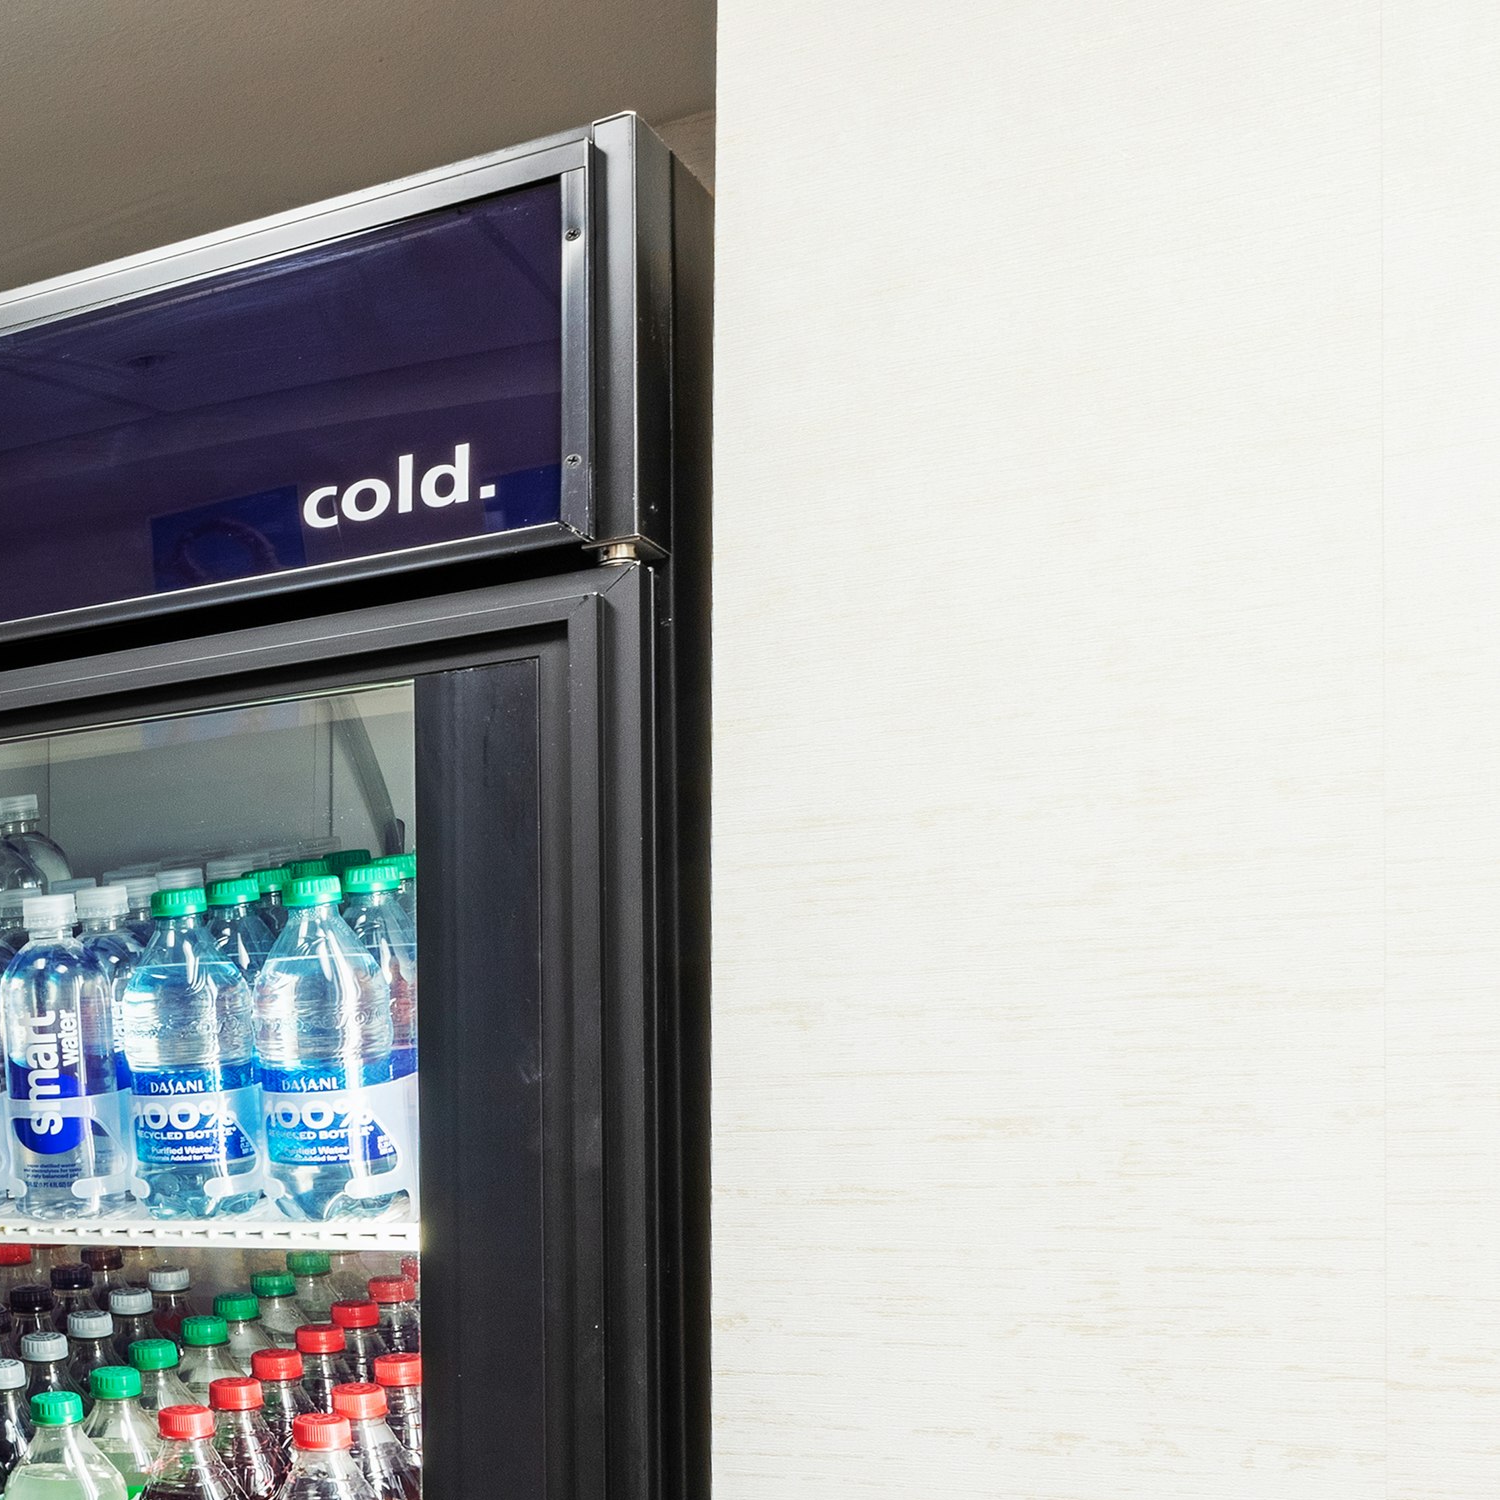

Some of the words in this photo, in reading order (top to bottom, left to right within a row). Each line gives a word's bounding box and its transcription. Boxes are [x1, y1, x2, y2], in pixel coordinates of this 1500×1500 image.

[303, 443, 496, 529] cold.
[26, 1010, 64, 1136] smart
[59, 1009, 80, 1067] water
[150, 1079, 205, 1096] DASANI
[281, 1076, 339, 1093] DASANI
[134, 1099, 237, 1130] 100%
[264, 1099, 374, 1129] 100%
[137, 1129, 184, 1140] RECYCLED
[151, 1146, 183, 1155] Purified
[183, 1145, 214, 1154] Water
